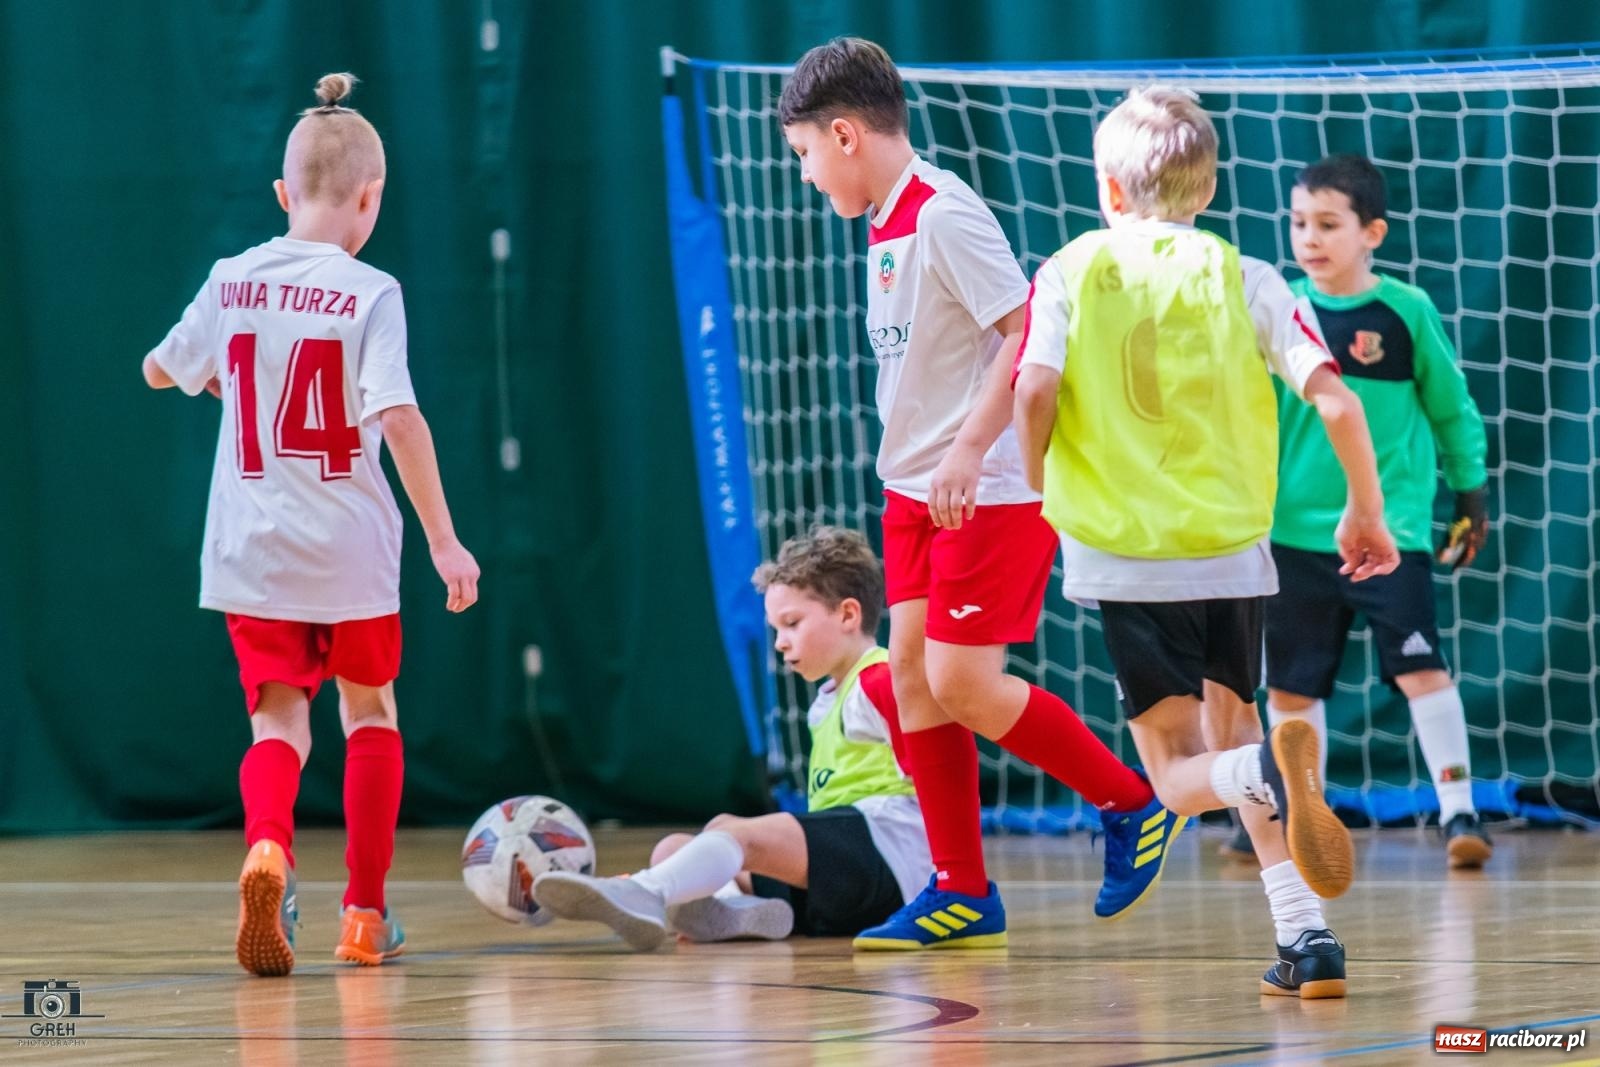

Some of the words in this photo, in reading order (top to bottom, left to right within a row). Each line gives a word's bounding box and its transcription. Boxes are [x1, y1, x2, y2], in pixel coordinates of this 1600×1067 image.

[220, 281, 268, 310] UNIA
[278, 284, 358, 319] TURZA
[228, 332, 362, 481] 14
